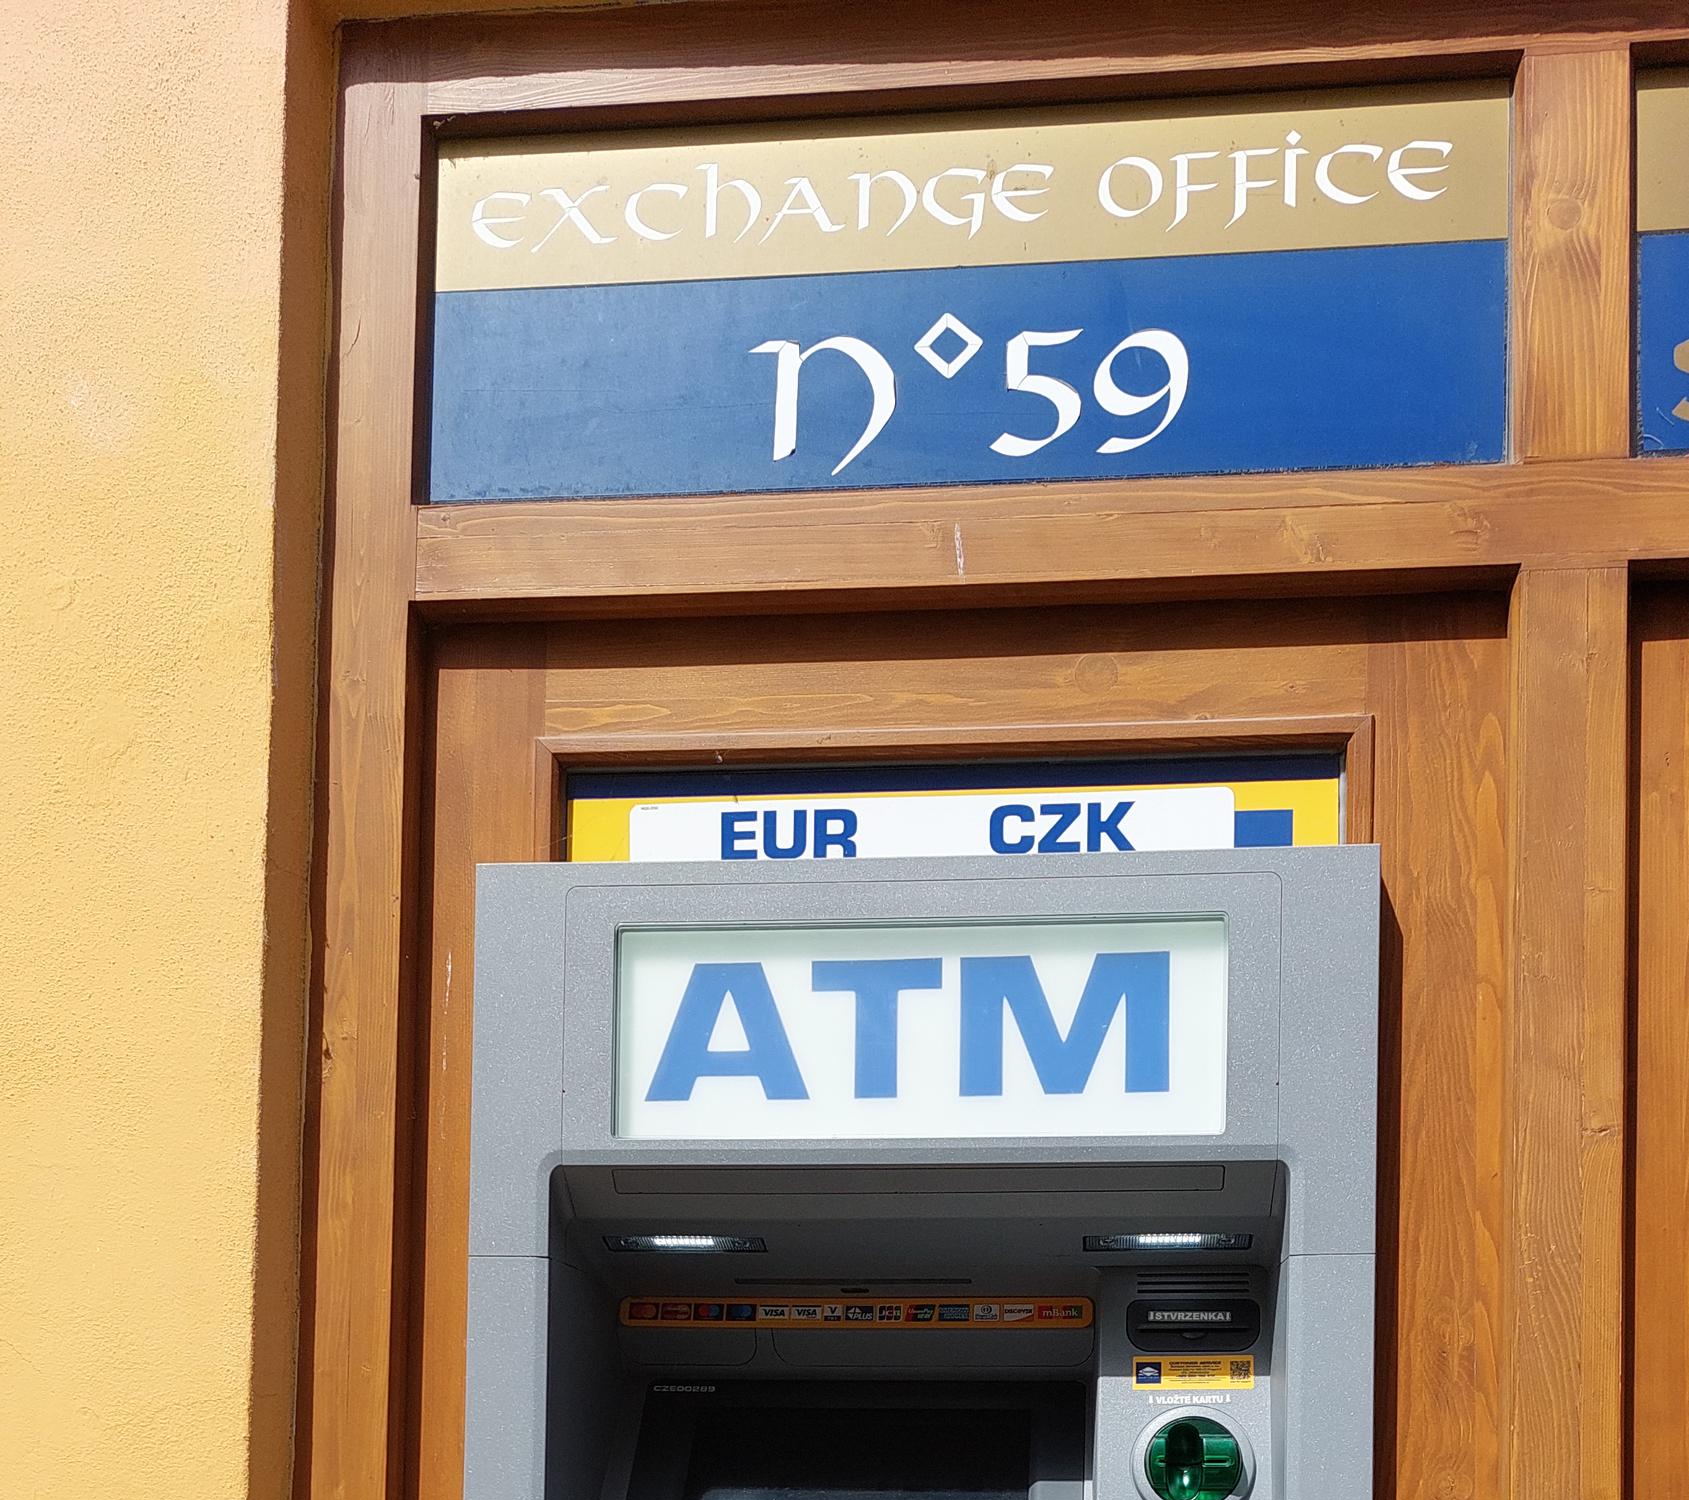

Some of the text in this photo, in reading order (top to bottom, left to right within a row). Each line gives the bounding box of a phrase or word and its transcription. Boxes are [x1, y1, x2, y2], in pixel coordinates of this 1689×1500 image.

[472, 130, 1453, 253] EXCHANGE OFFICE
[721, 801, 1136, 860] EUR CZK
[645, 950, 1170, 1103] ATM
[763, 1308, 818, 1318] VISA VISA
[1042, 1307, 1079, 1318] mBank
[1155, 1311, 1225, 1321] STVRZENKA
[1192, 1395, 1224, 1404] KARTU
